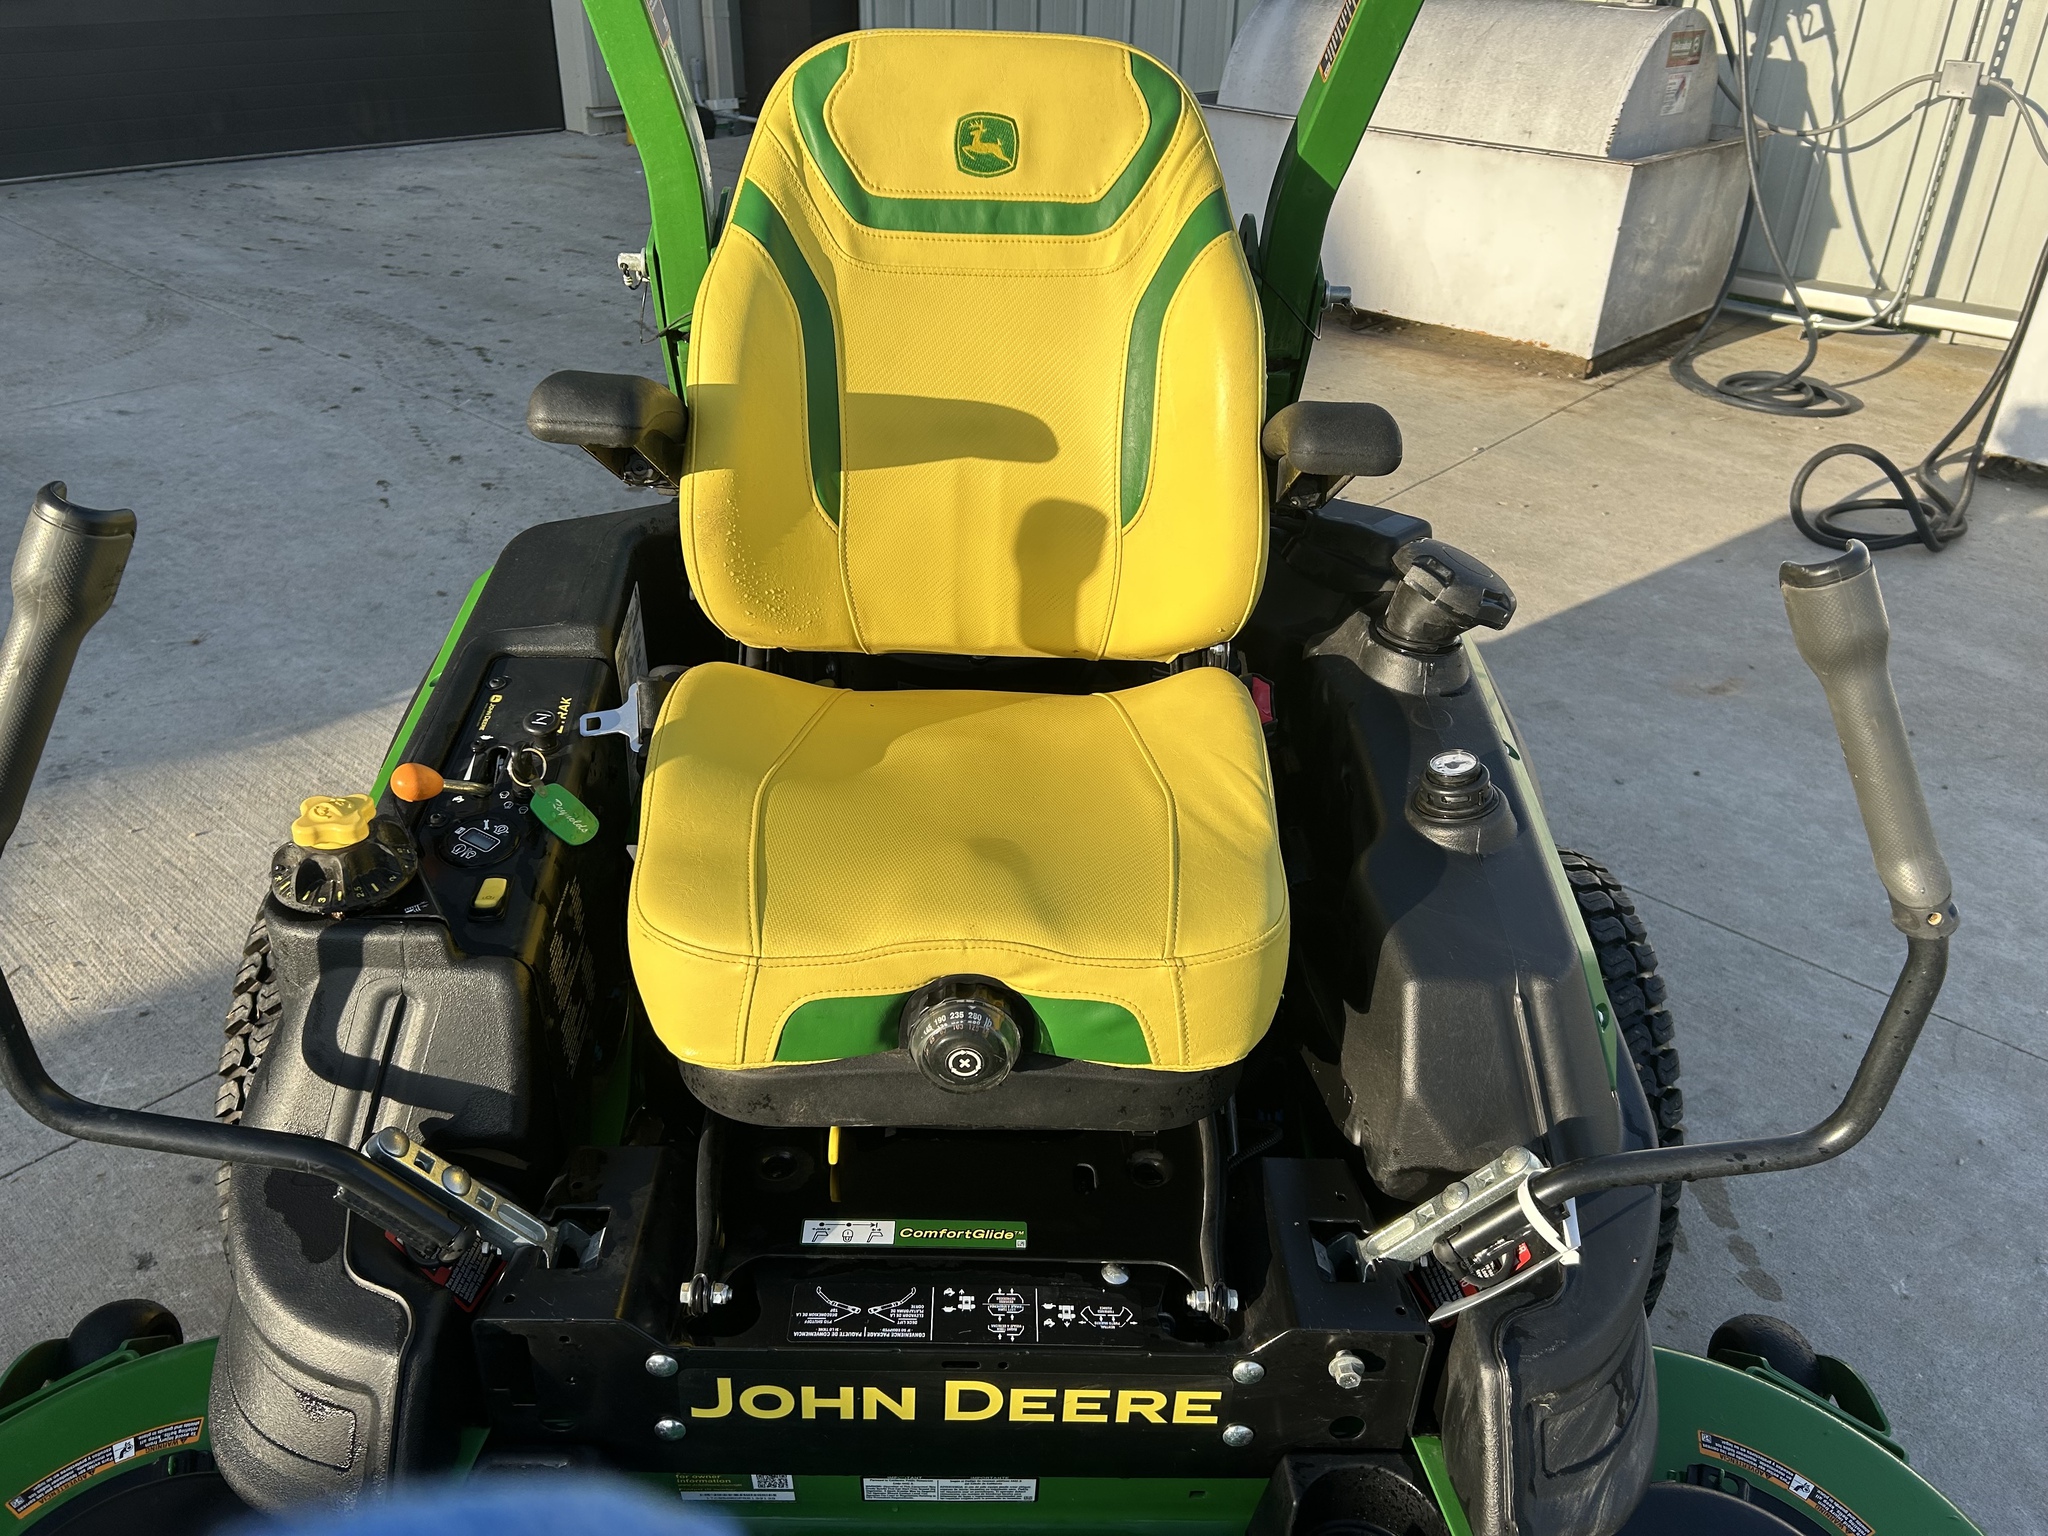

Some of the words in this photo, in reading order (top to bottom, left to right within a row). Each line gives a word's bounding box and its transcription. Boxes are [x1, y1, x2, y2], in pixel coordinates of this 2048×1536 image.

[552, 798, 589, 833] Reynolds
[934, 1015, 946, 1026] 190
[949, 1011, 964, 1020] 235
[968, 1012, 982, 1021] 280
[691, 1377, 916, 1420] JOHN
[944, 1380, 1224, 1424] DEERE
[145, 1440, 179, 1453] WARNING
[1719, 1454, 1764, 1476] ADVERTENCIA
[39, 1473, 87, 1504] ADVERTENCIA
[1815, 1504, 1844, 1530] WARNING
